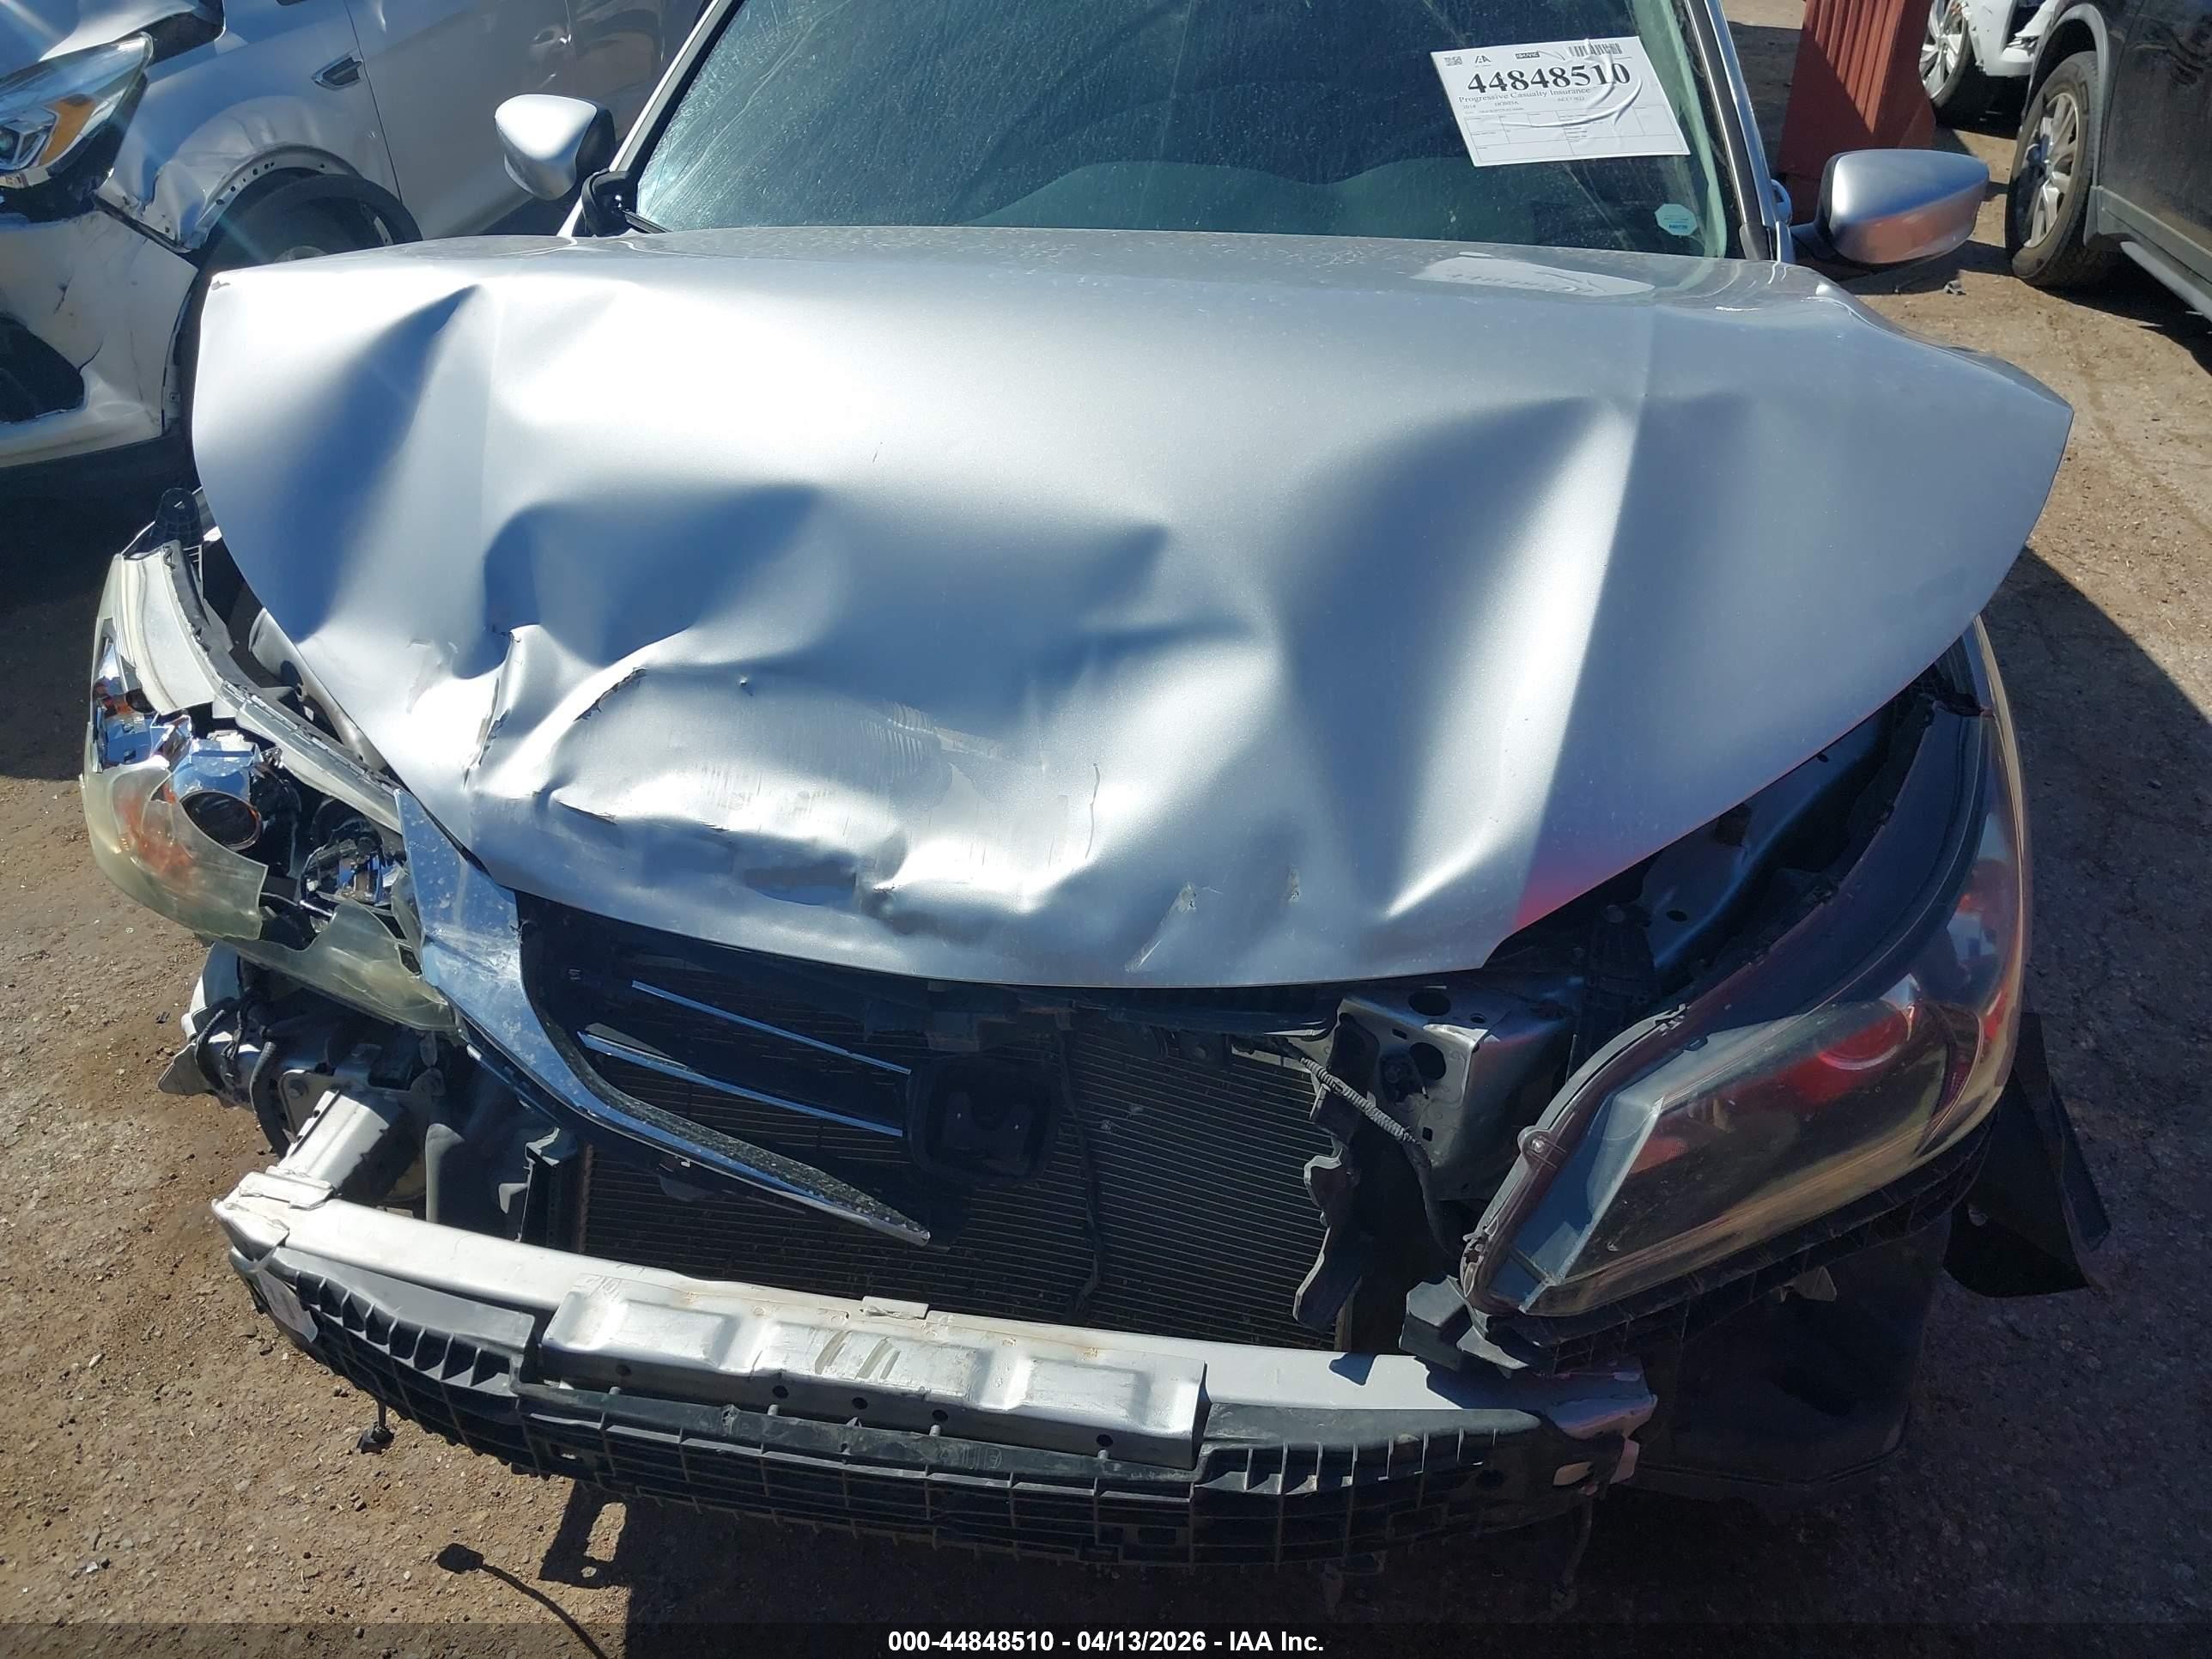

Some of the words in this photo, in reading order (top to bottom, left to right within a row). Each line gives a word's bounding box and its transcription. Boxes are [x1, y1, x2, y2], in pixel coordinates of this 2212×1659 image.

[1468, 63, 1631, 94] 44848510
[1458, 94, 1509, 103] Progressive
[1510, 89, 1547, 99] Casualty
[1550, 88, 1591, 96] Insurance
